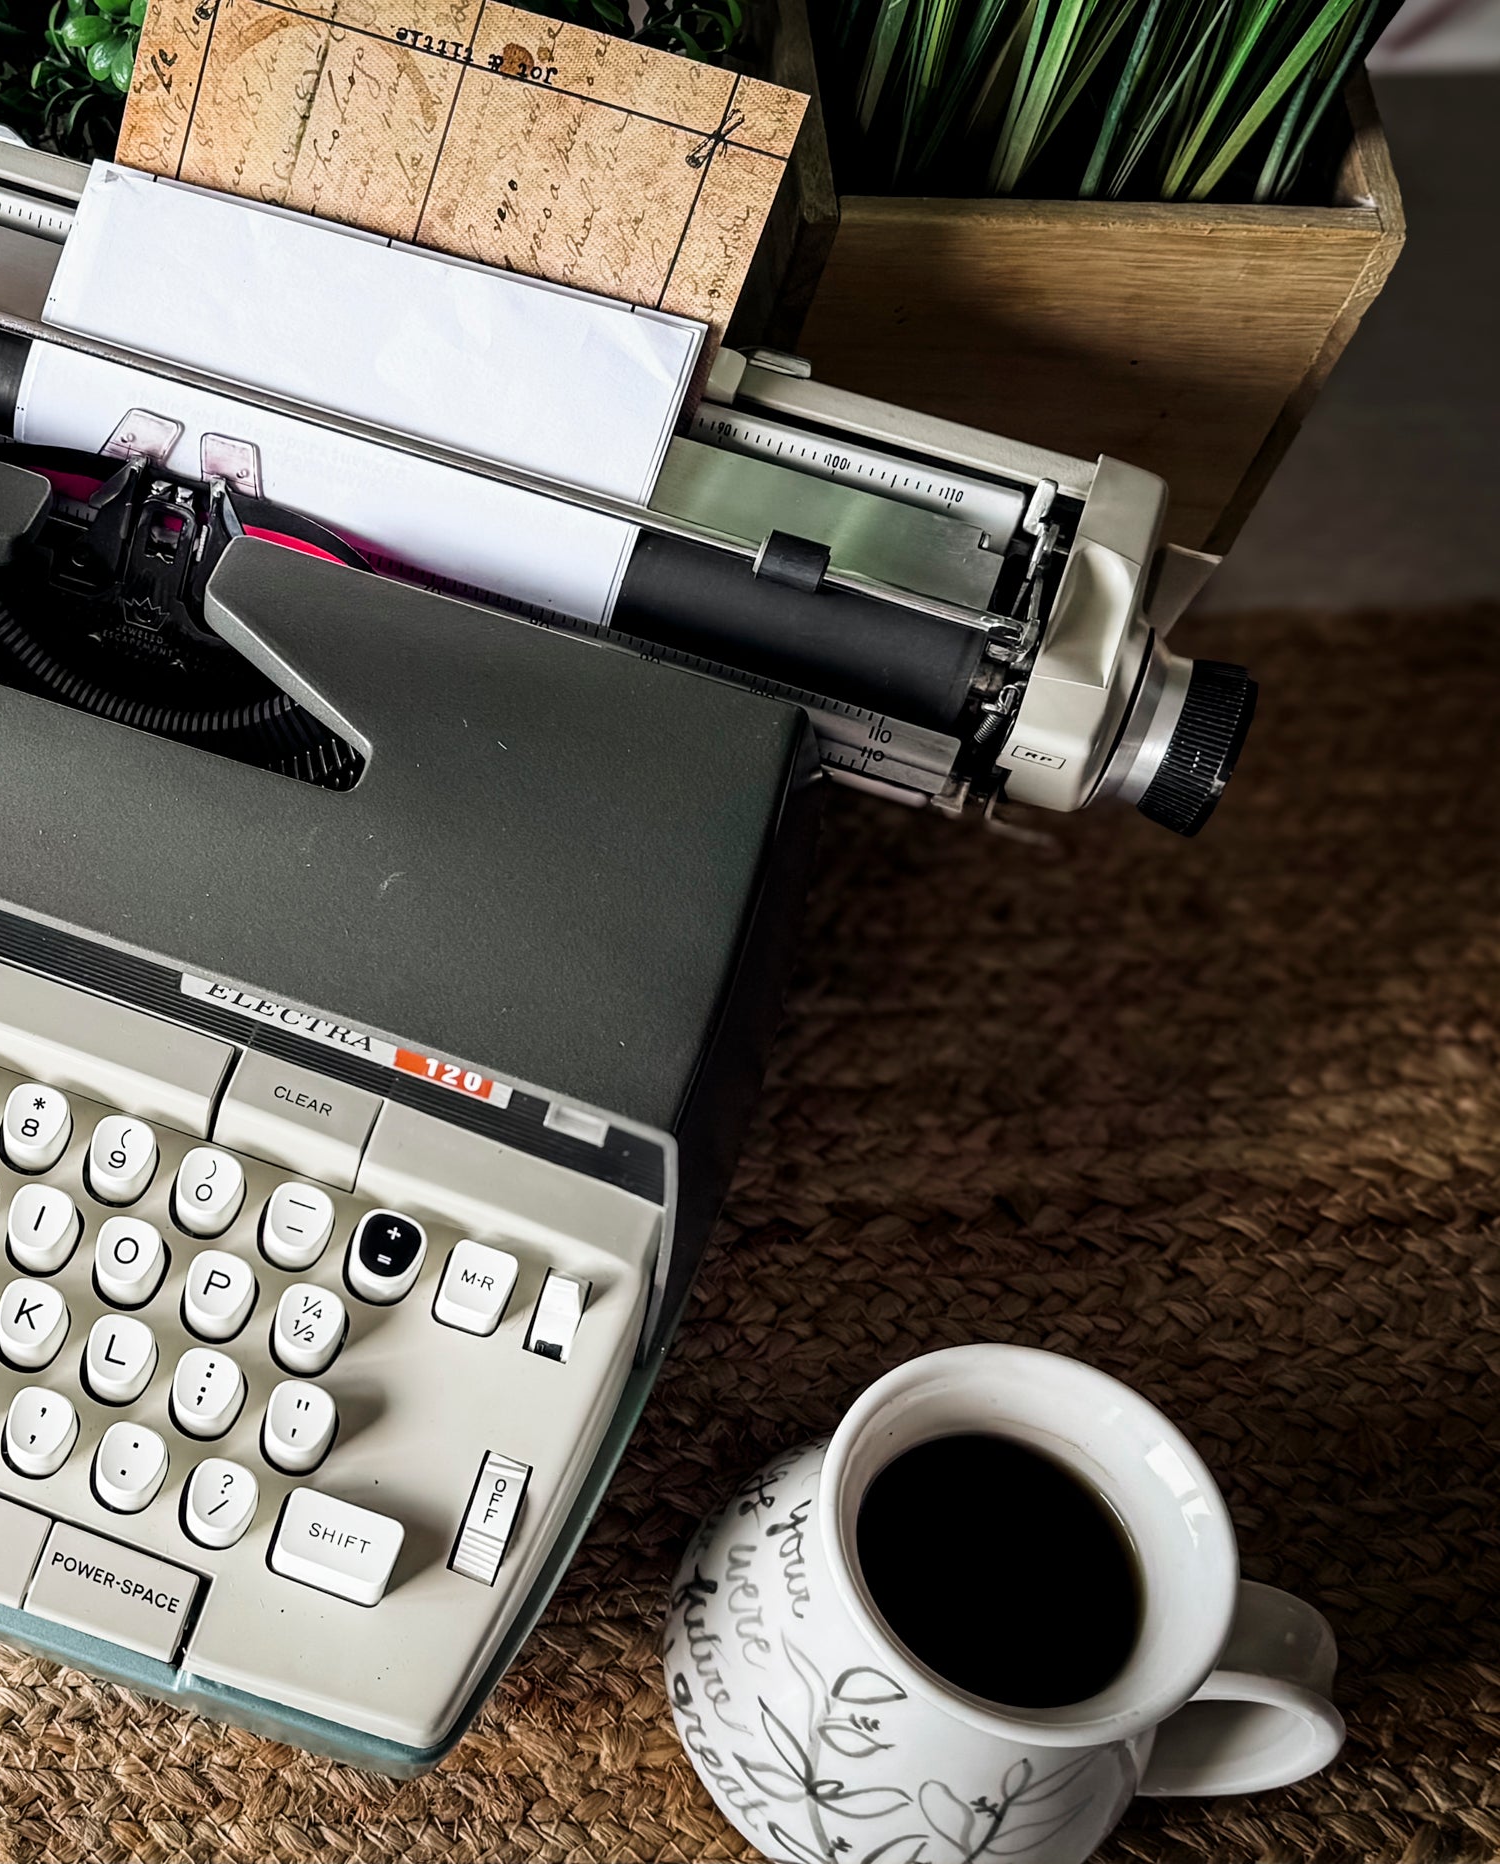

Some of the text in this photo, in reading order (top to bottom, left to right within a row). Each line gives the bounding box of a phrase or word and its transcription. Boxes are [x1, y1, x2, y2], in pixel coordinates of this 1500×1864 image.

[716, 421, 732, 437] 90
[944, 486, 965, 503] 110
[868, 725, 892, 744] 110
[205, 982, 483, 1093] ELECTRA 120
[273, 1085, 333, 1117] CLEAR
[20, 1118, 40, 1138] 8
[107, 1150, 127, 1169] 9
[113, 1236, 140, 1265] O
[202, 1269, 231, 1296] P
[13, 1297, 44, 1330] K
[104, 1333, 126, 1366] L
[483, 1478, 508, 1525] OFF
[308, 1522, 371, 1554] SHIFT
[765, 1499, 813, 1619] your
[51, 1552, 180, 1614] POWER-SPACE
[725, 1543, 771, 1670] were
